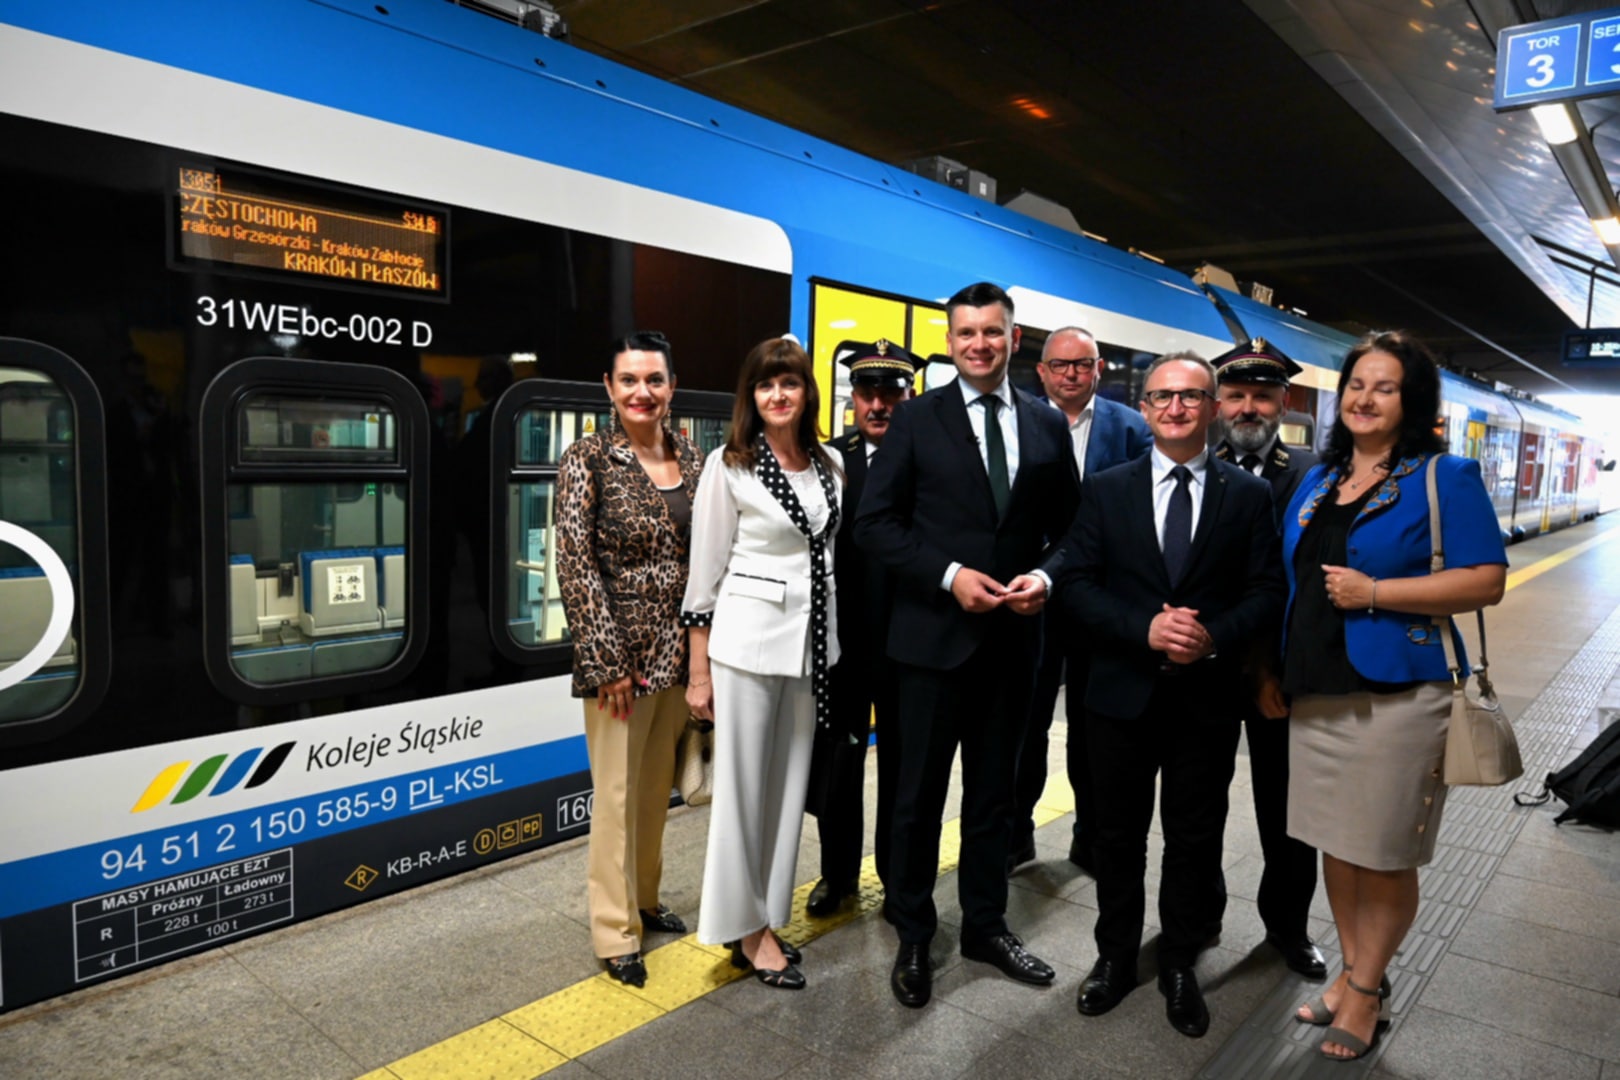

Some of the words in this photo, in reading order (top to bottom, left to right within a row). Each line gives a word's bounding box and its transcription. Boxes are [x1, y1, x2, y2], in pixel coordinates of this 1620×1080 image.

[1527, 35, 1560, 51] TOR
[1525, 54, 1555, 88] 3
[181, 218, 231, 238] raków
[284, 251, 356, 278] KRAKÓW
[361, 262, 437, 289] PŁASZÓW
[196, 296, 402, 345] 31WEbc-002
[412, 321, 433, 347] D
[306, 733, 391, 772] Koleje
[397, 715, 483, 754] Śląskie
[101, 843, 147, 879] 94
[161, 831, 199, 865] 51
[216, 823, 236, 852] 2
[250, 807, 306, 842] 150
[316, 786, 397, 827] 585-9
[409, 763, 503, 808] PL-KSL
[523, 821, 539, 835] ep
[480, 834, 490, 849] D
[386, 840, 467, 878] KB-R-A-E
[102, 888, 150, 911] MASY
[154, 864, 239, 897] HAMUJĄCE
[244, 856, 270, 872] EZT
[356, 871, 366, 886] R
[152, 893, 204, 916] Próżny
[224, 871, 286, 896] Ładowny
[244, 893, 267, 910] 273
[269, 892, 274, 902] t
[164, 915, 190, 932] 228
[193, 913, 199, 924] t
[206, 921, 229, 937] 100
[232, 919, 238, 930] t
[100, 928, 113, 941] R
